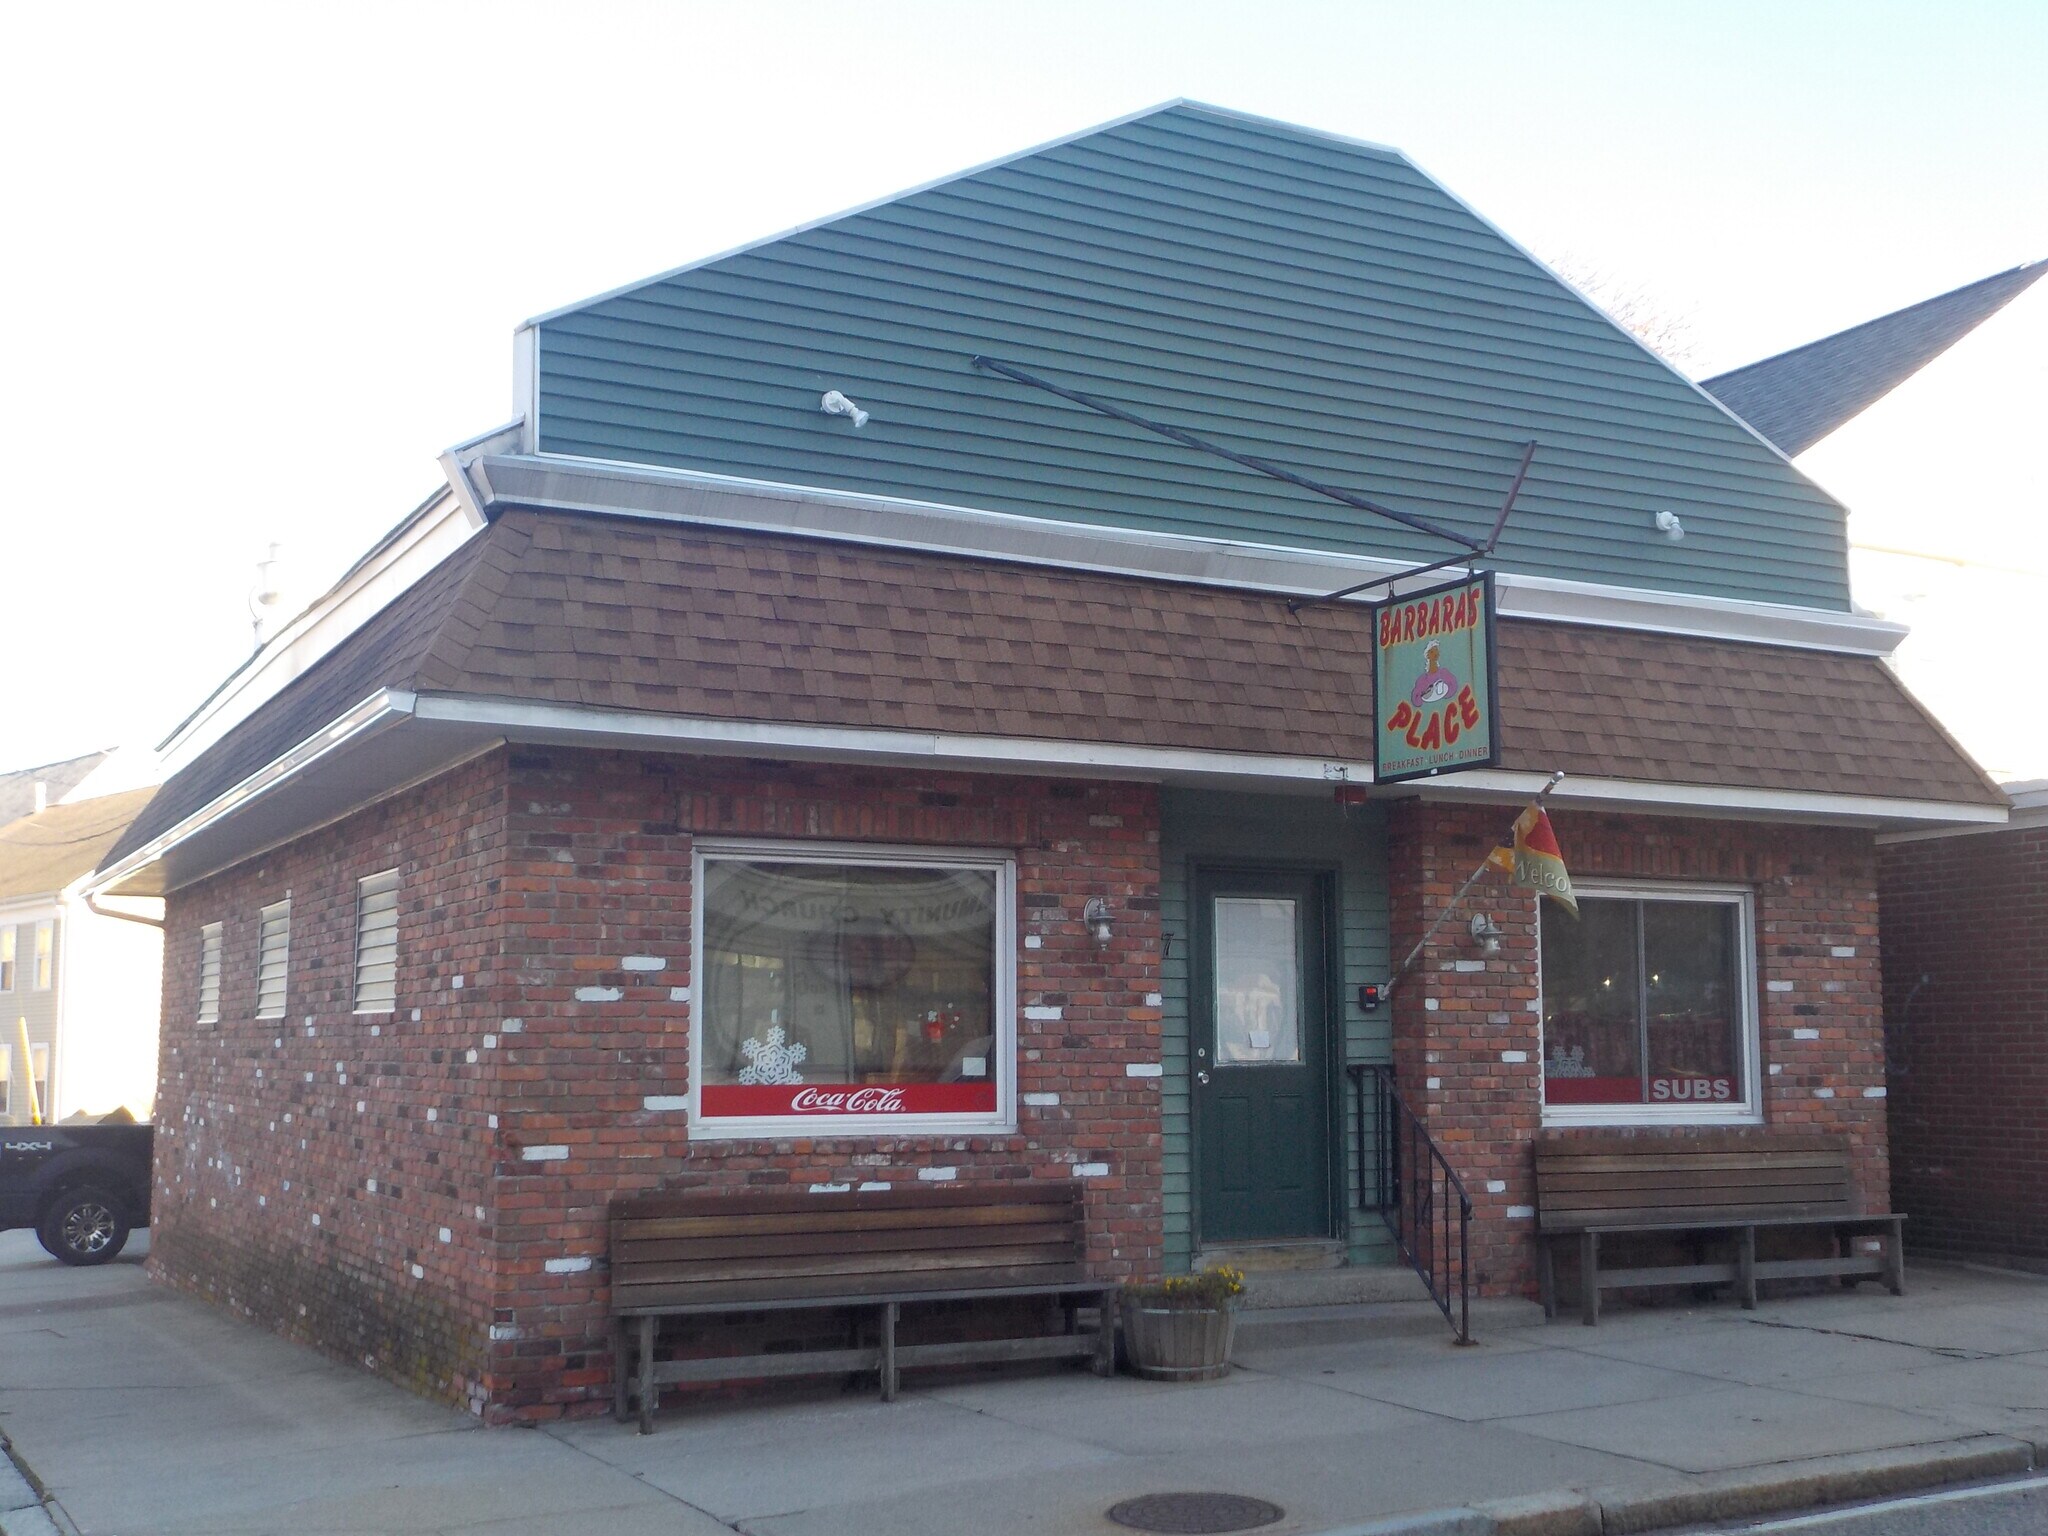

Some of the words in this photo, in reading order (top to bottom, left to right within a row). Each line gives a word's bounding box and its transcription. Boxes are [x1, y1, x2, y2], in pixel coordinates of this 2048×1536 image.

[1387, 684, 1480, 750] PLACE
[1382, 756, 1424, 773] BREAKFAST
[1428, 752, 1454, 765] LUNCH
[1459, 746, 1488, 760] DINNER
[791, 1087, 906, 1112] Coca-Cola
[1653, 1079, 1731, 1100] SUBS
